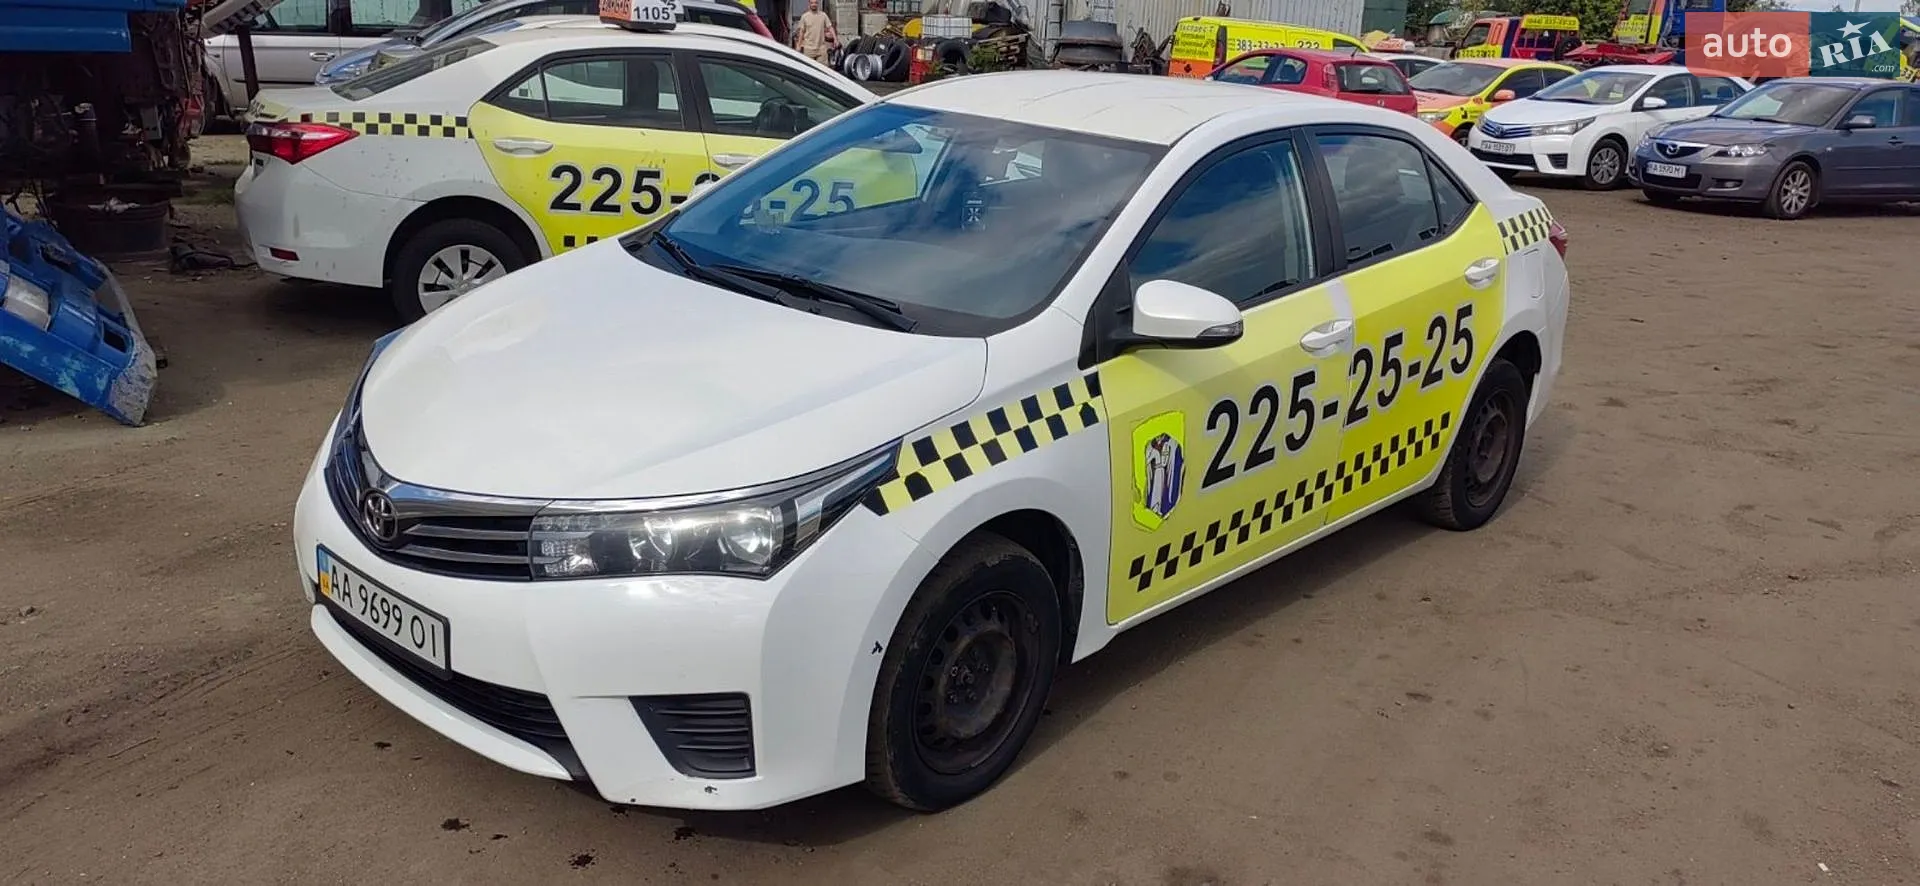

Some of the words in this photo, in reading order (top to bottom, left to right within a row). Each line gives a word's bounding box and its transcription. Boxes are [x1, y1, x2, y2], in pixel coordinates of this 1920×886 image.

[633, 6, 670, 20] 1105
[1201, 304, 1474, 490] 225-25-25
[331, 564, 353, 609] AA
[358, 583, 403, 637] 9699
[410, 615, 437, 658] OI
